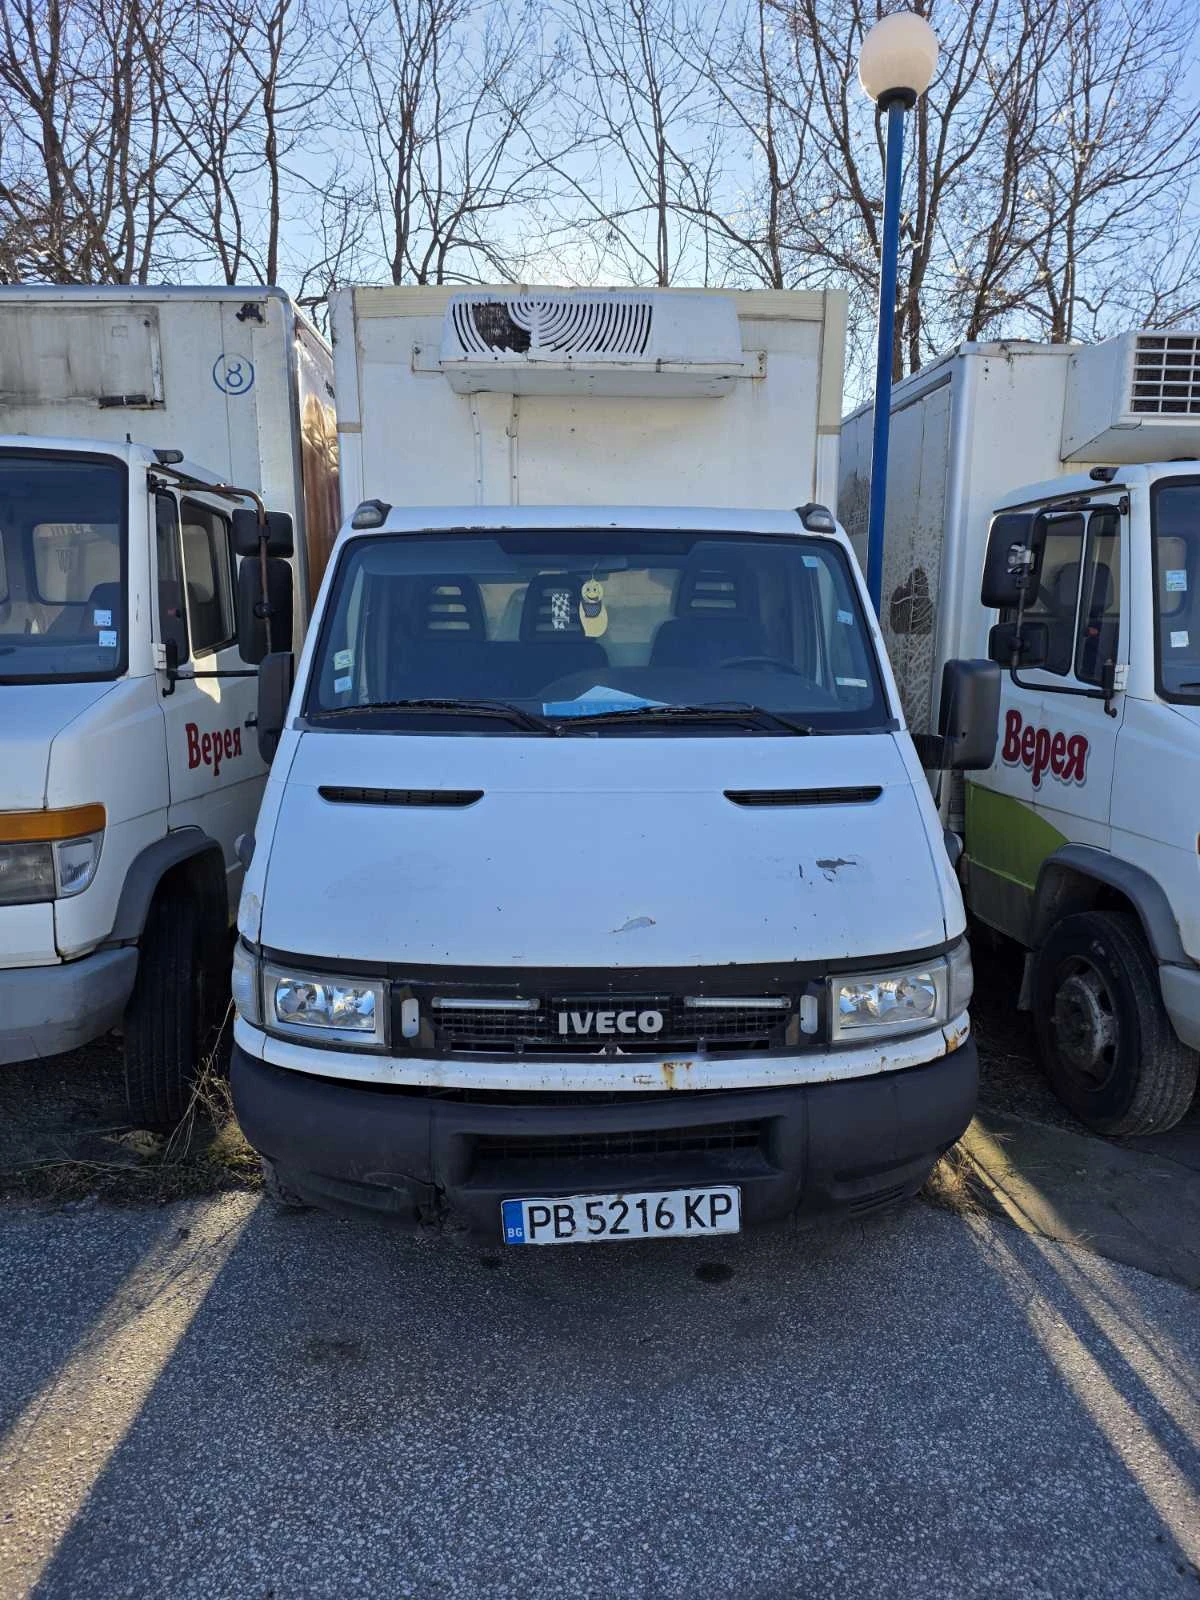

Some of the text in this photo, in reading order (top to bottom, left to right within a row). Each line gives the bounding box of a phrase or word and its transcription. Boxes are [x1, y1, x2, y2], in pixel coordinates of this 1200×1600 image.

[185, 722, 242, 776] Верея
[1002, 709, 1089, 787] Верея
[558, 1010, 663, 1034] IVECO
[507, 1227, 523, 1238] BG
[528, 1193, 732, 1239] PB 5216 KP
